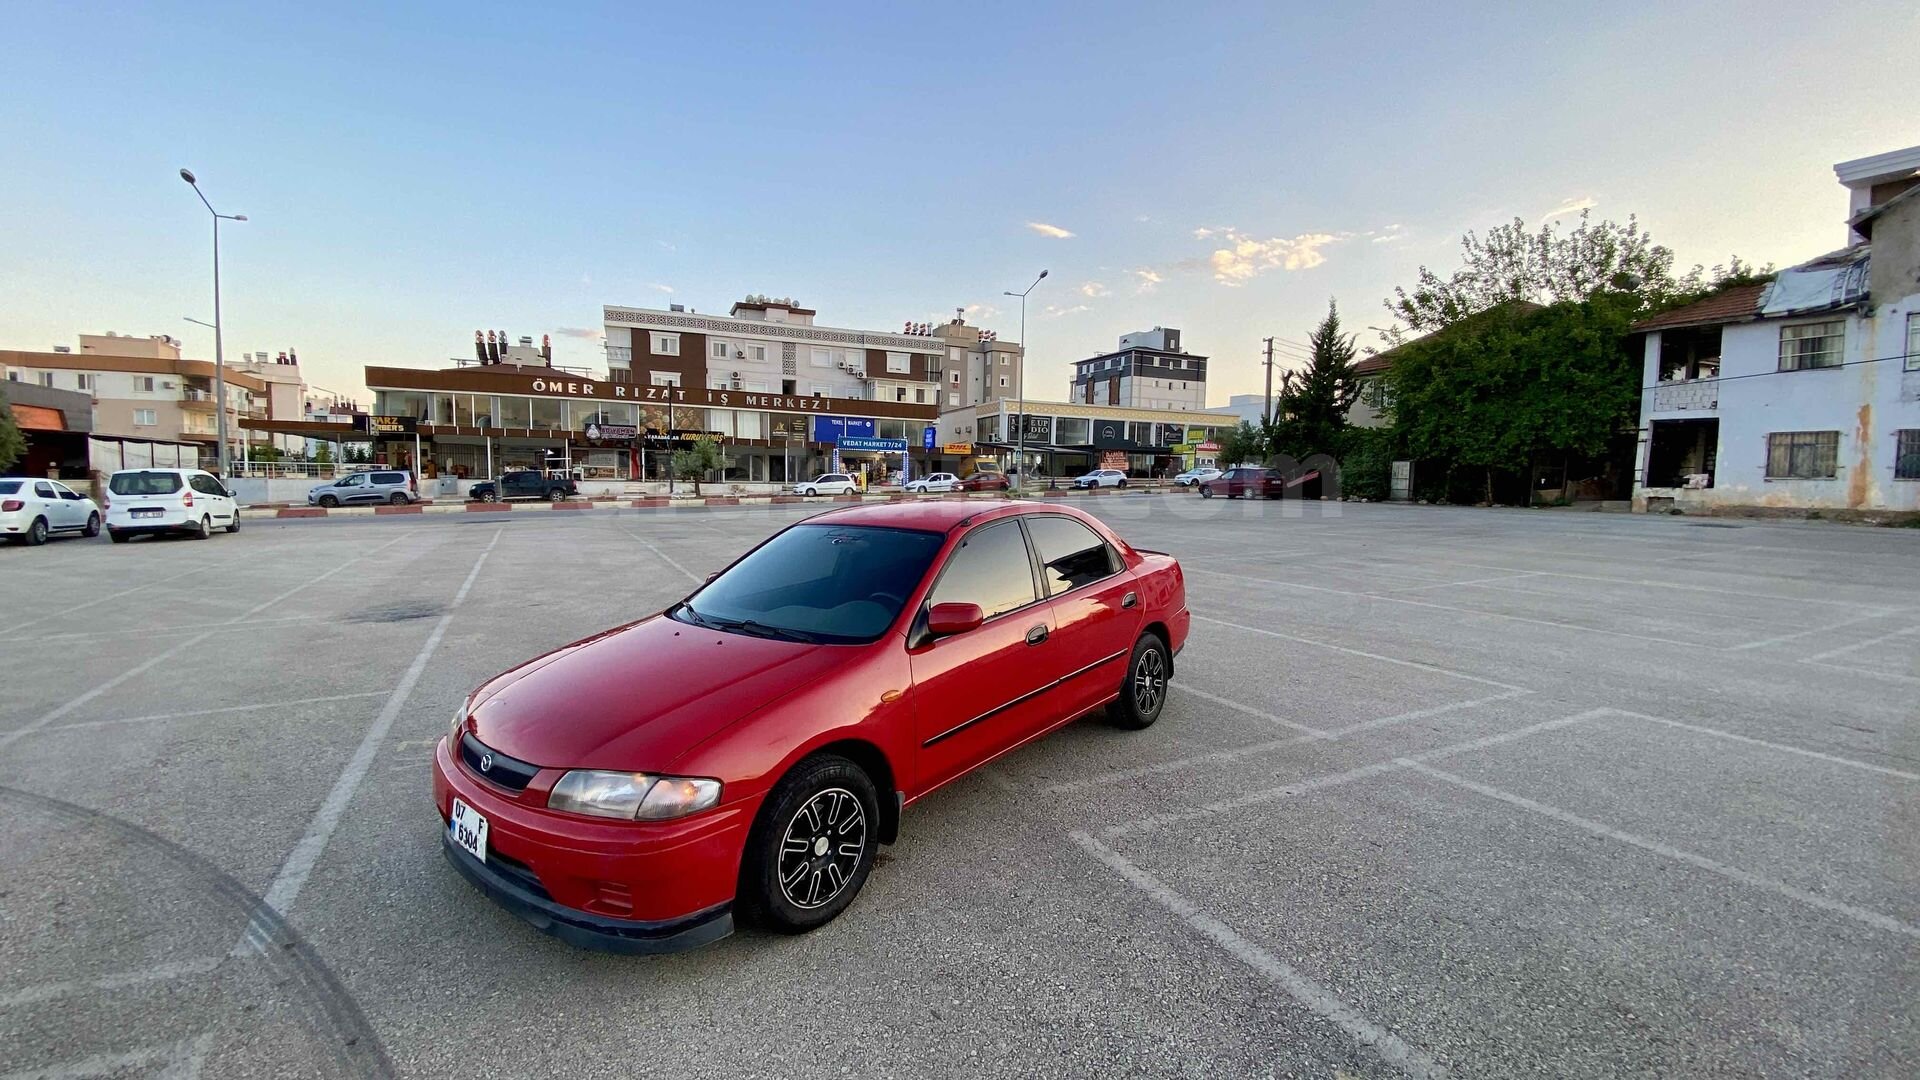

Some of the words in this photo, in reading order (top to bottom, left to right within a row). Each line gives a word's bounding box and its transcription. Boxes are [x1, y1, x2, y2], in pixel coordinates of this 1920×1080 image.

[532, 378, 594, 395] ÖMER
[615, 386, 686, 401] RIZAT
[707, 390, 729, 406] İŞ
[746, 395, 831, 411] MERKEZİ
[1010, 425, 1049, 434] SDIO
[455, 800, 466, 819] 07
[478, 817, 484, 834] F
[458, 824, 478, 853] 6304
